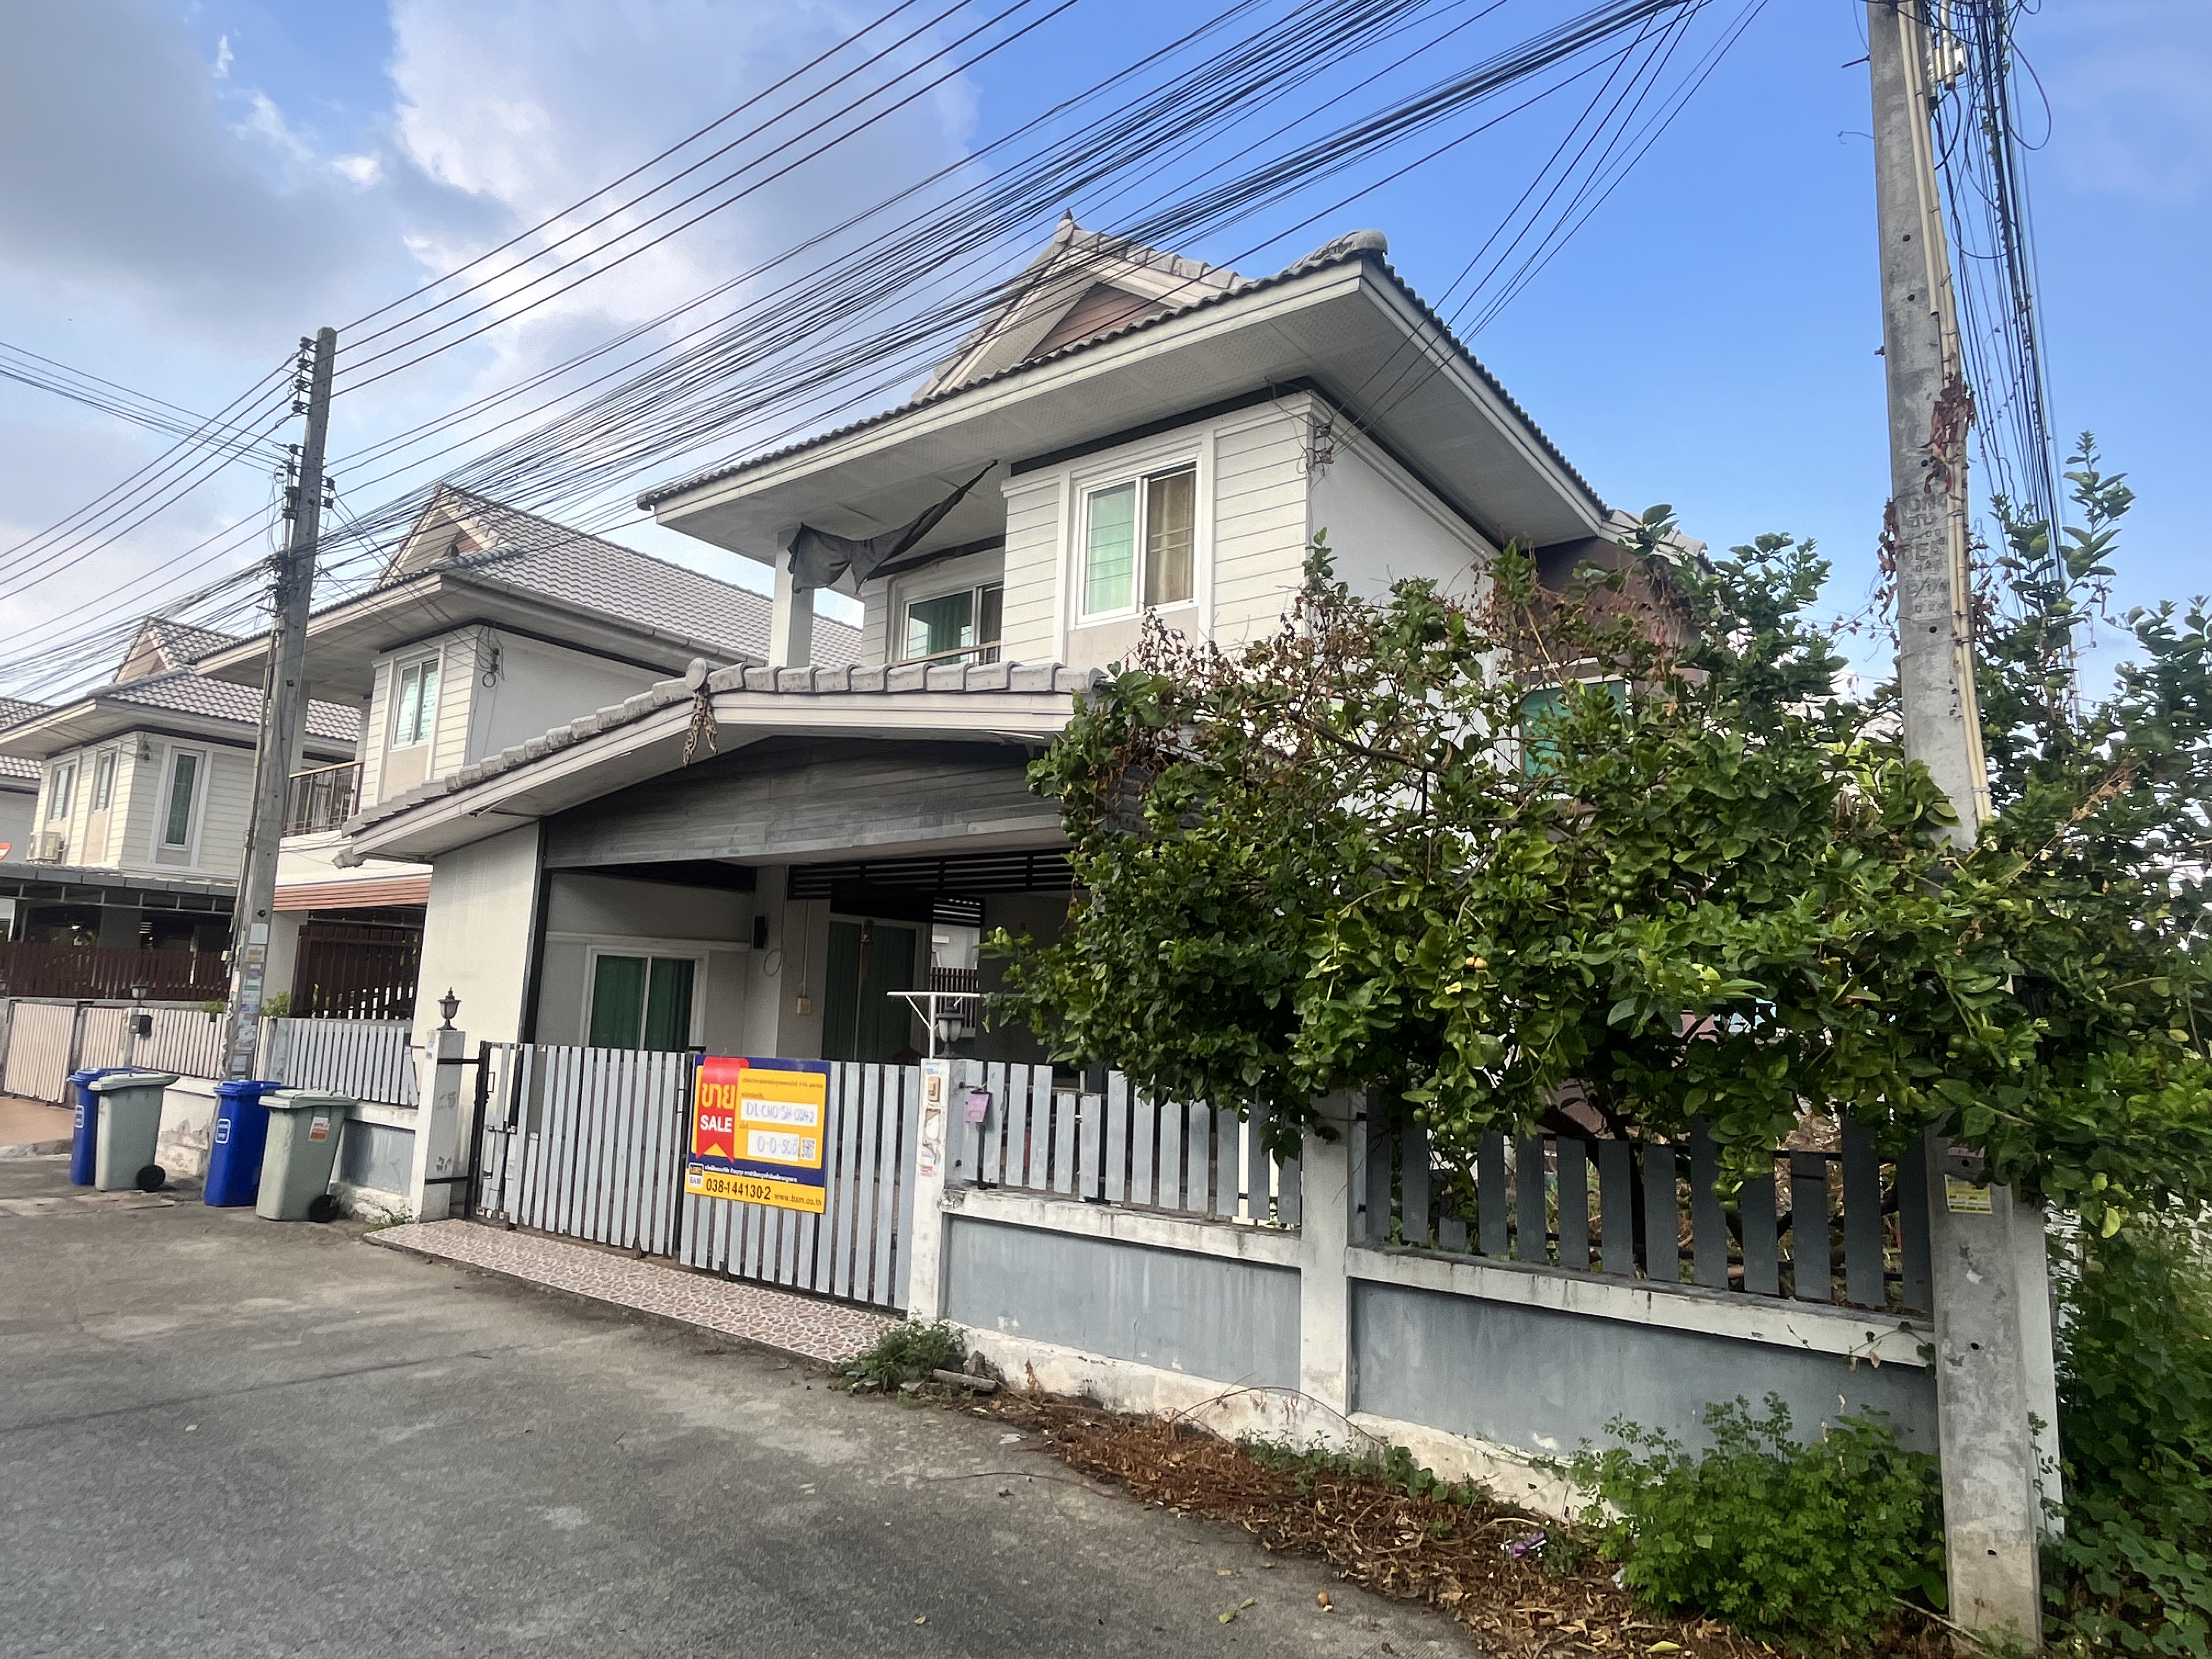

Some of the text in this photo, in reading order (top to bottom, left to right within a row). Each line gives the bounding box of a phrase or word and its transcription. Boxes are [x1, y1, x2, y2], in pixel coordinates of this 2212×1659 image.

[702, 1083, 735, 1109] ขาย
[700, 1114, 733, 1132] SALE
[706, 1178, 822, 1206] 038-144130-2 www.bam.co.th
